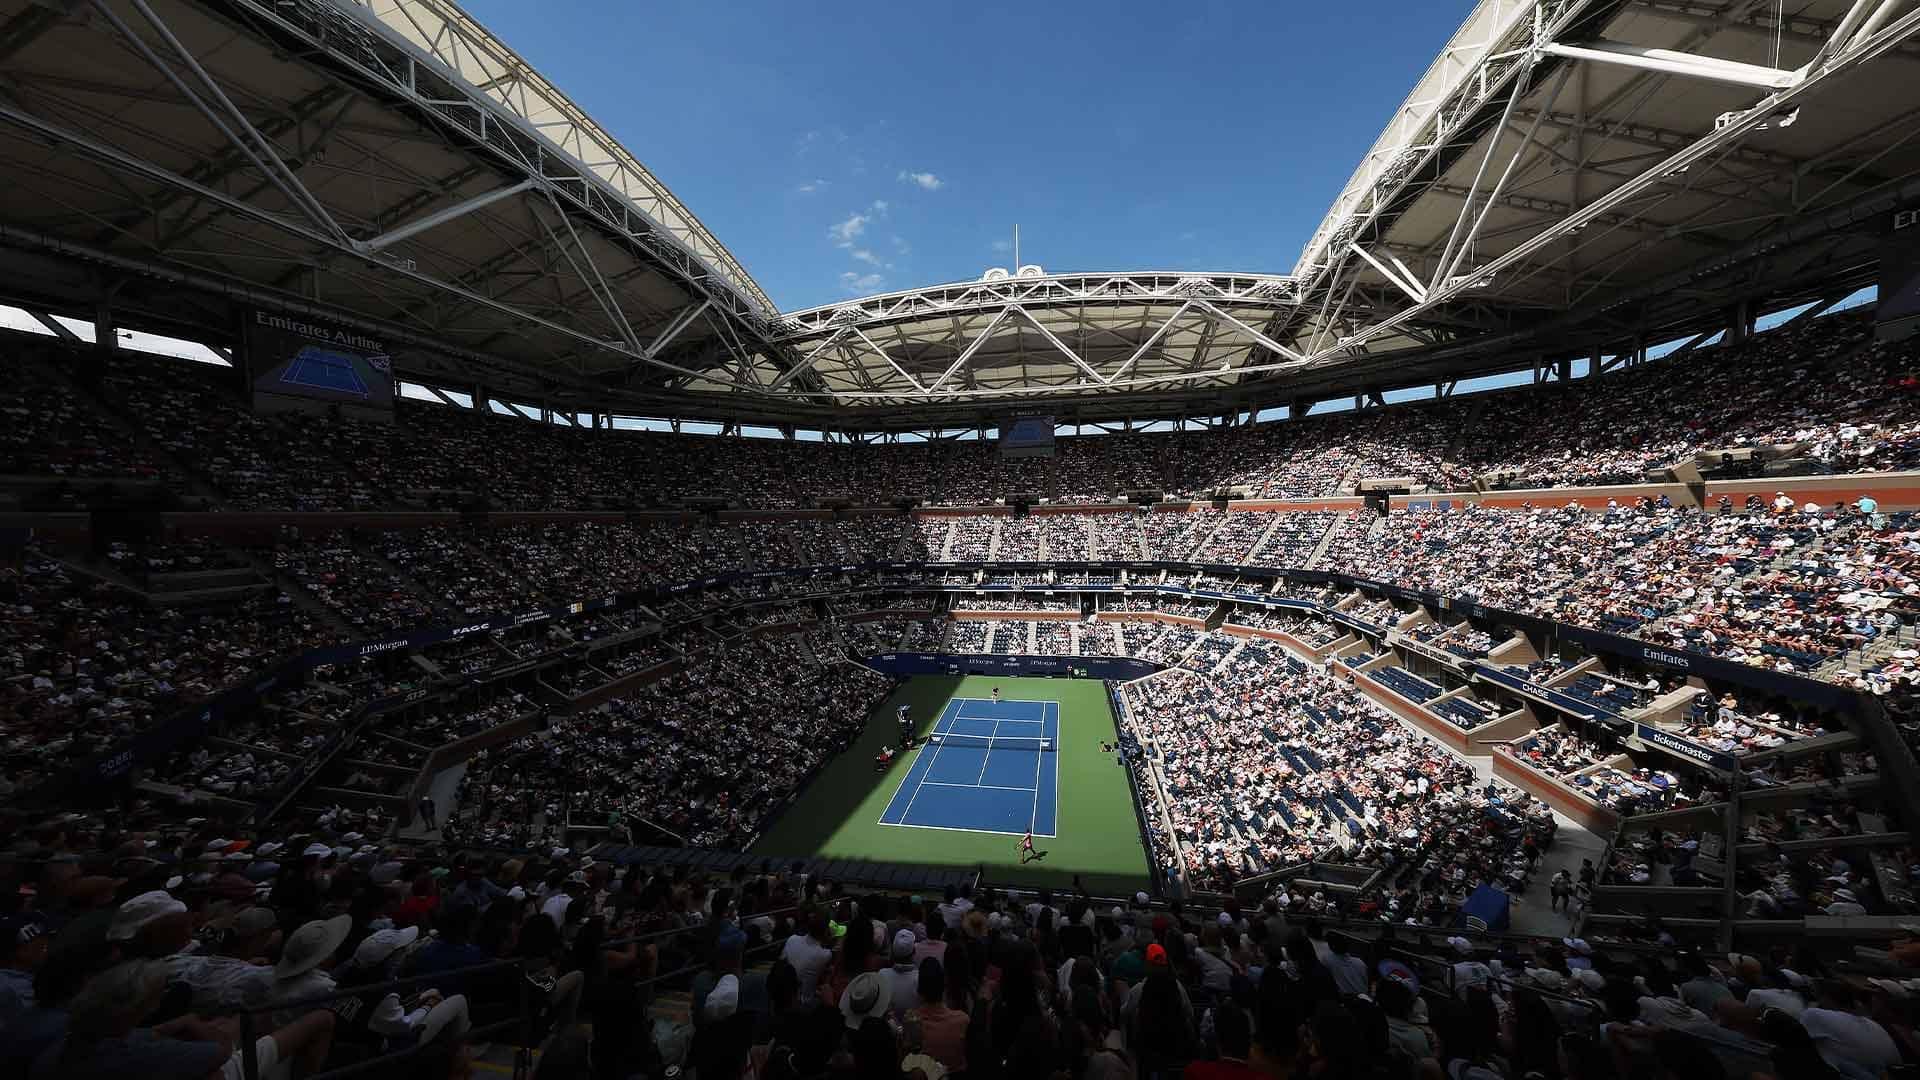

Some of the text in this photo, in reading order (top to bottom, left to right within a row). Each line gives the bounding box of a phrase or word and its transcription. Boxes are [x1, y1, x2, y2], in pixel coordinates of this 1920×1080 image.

[256, 310, 383, 351] Emirates Airline
[1643, 647, 1689, 667] Emirates
[1522, 683, 1549, 699] CHASE
[1653, 733, 1713, 761] ticketmaster
